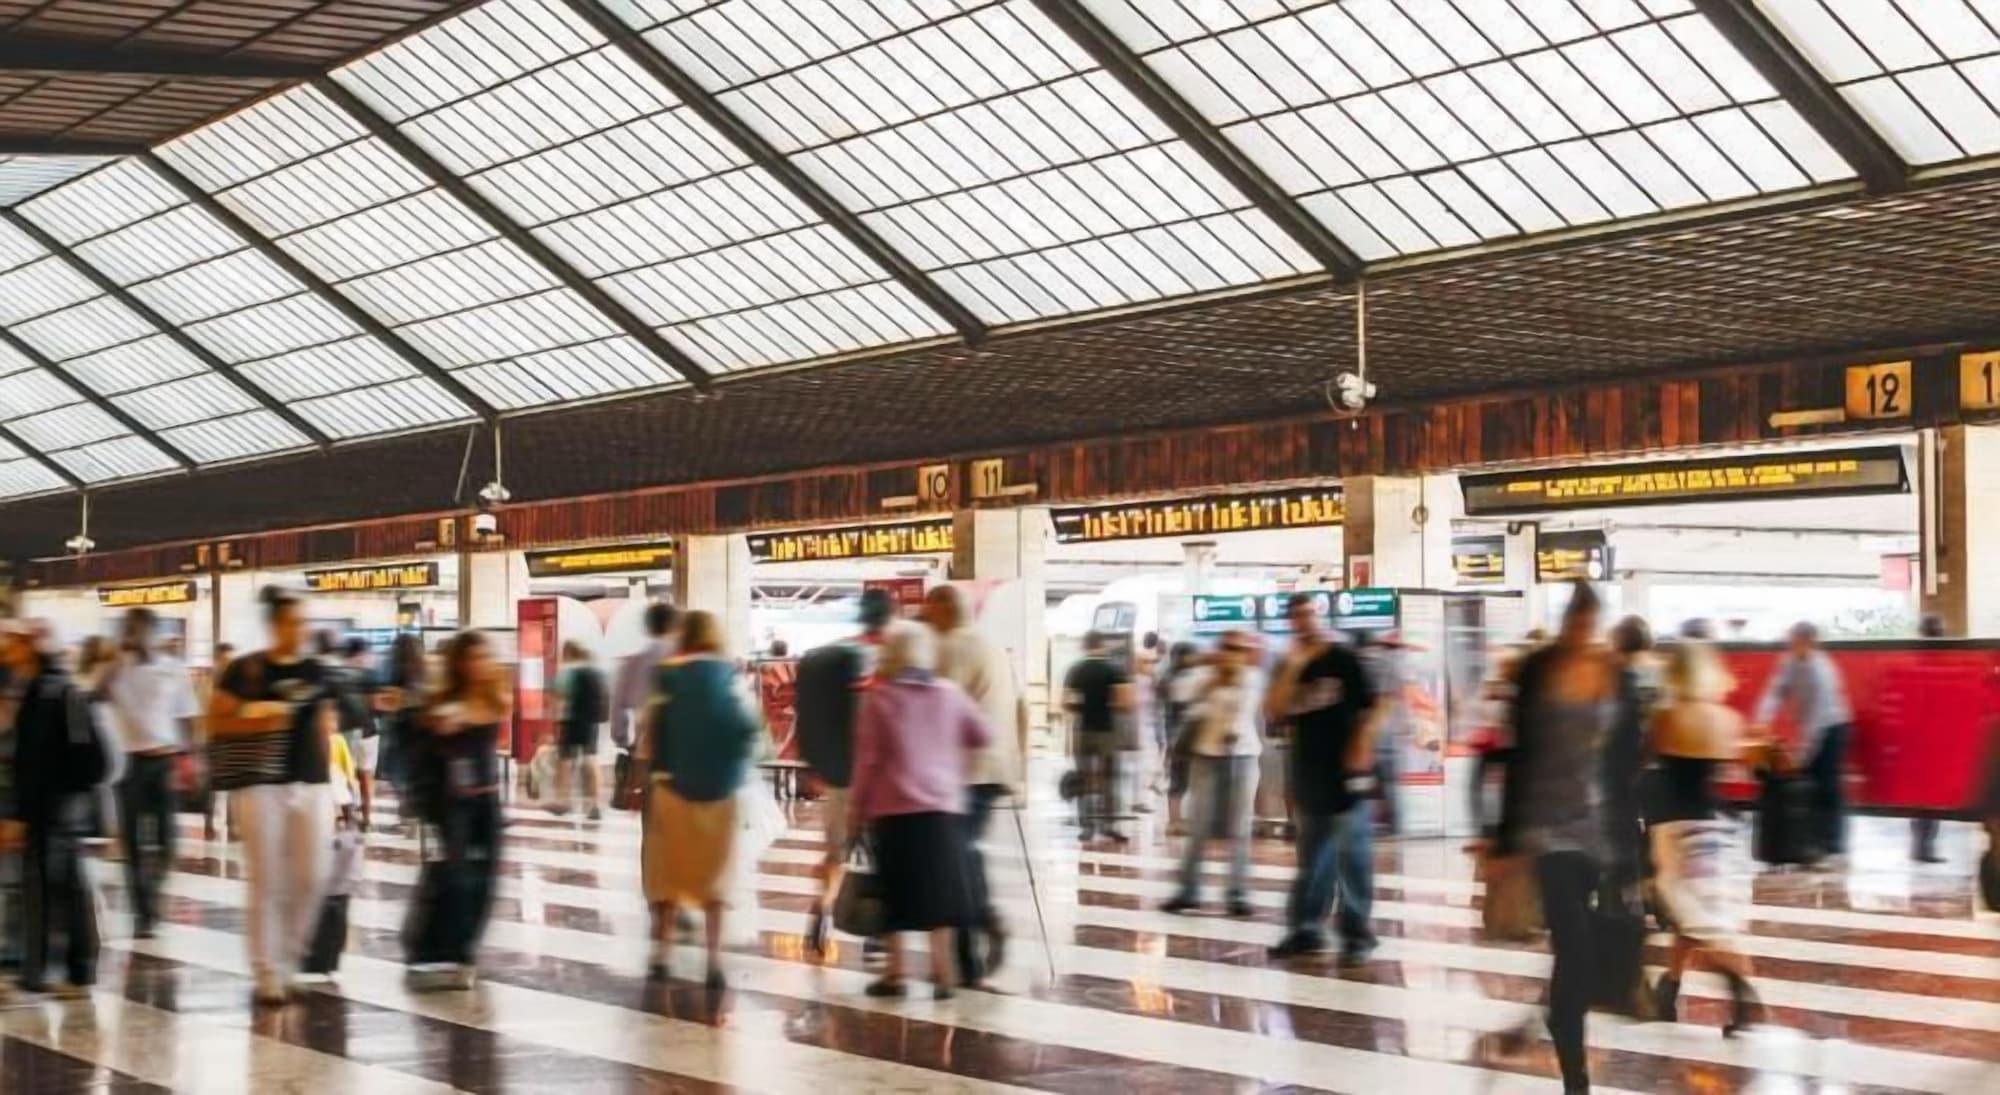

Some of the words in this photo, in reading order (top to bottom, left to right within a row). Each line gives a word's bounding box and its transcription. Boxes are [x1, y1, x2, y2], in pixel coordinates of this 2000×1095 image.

[1866, 372, 1900, 416] 12
[1982, 360, 2000, 404] 1
[927, 471, 947, 499] 10
[983, 465, 999, 496] 11
